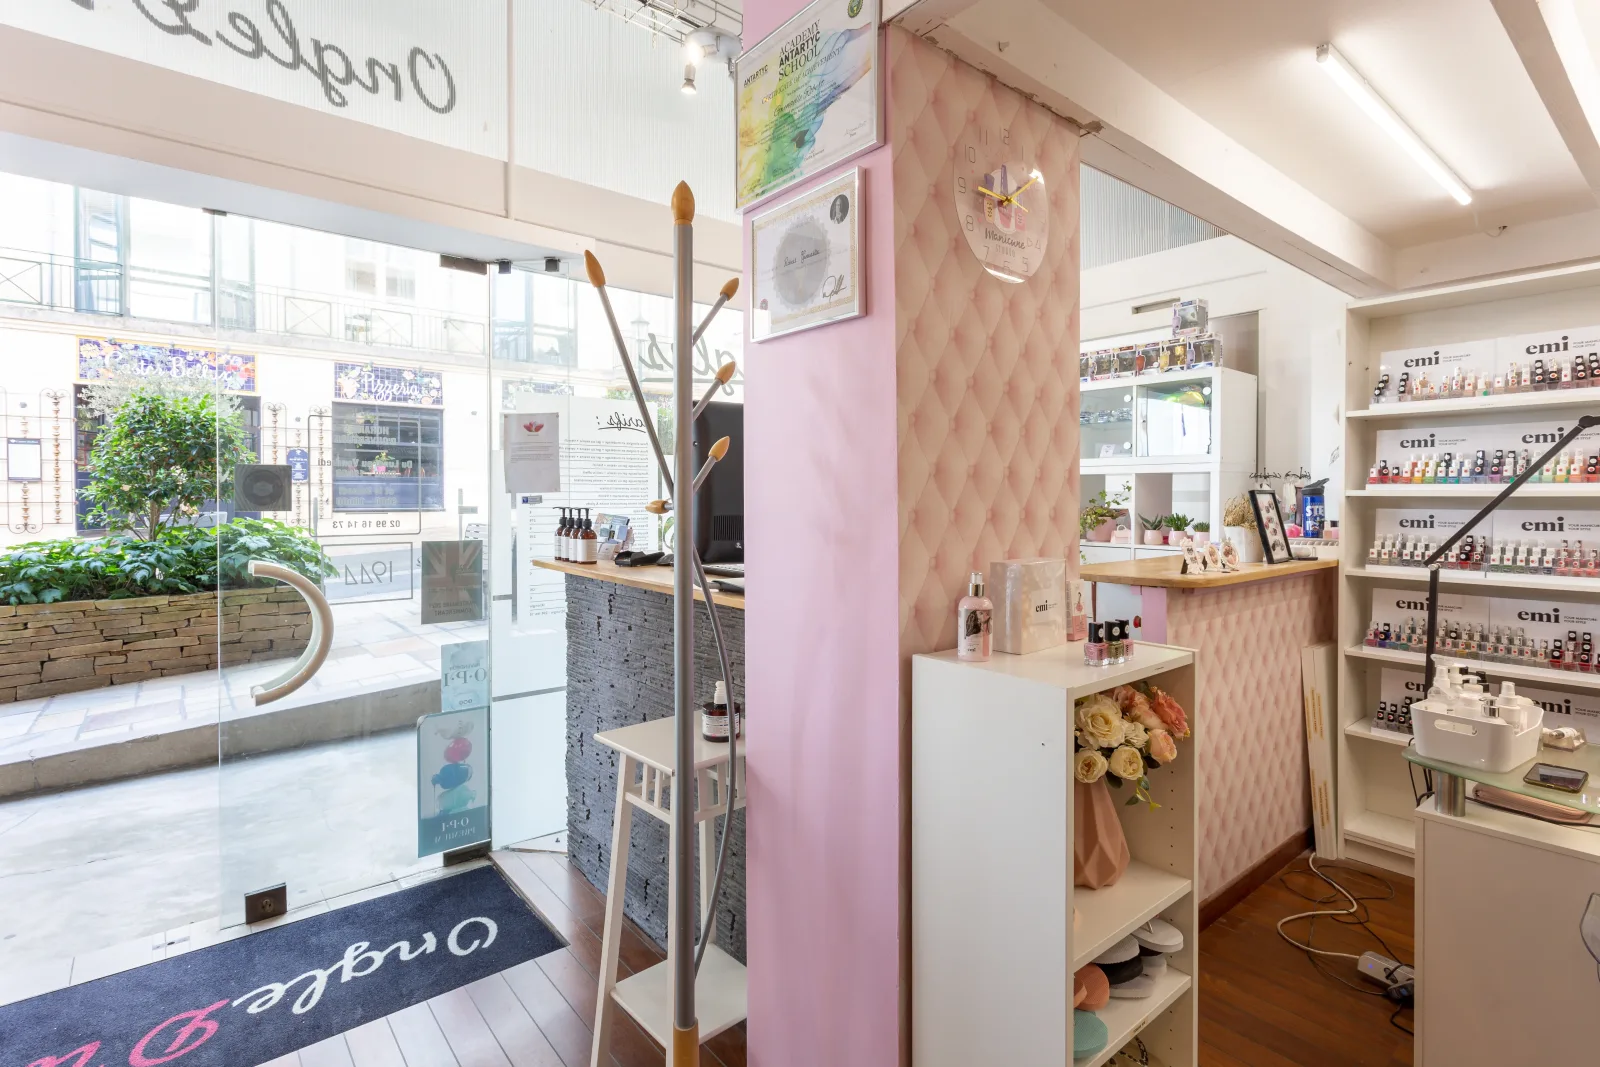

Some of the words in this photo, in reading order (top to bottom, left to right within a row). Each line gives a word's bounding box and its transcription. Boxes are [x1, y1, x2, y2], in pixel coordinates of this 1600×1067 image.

[779, 19, 821, 57] ACADEMY
[779, 30, 821, 68] ANTARTYC
[778, 44, 821, 82] SCHOOL
[743, 64, 768, 87] ANTARTYC
[965, 144, 976, 164] 10
[958, 176, 967, 194] 9
[965, 214, 974, 232] 8
[984, 227, 1026, 250] Manicure
[1526, 335, 1569, 355] emi
[1404, 350, 1440, 368] emi
[362, 371, 420, 402] Pizzeria
[1400, 433, 1436, 448] emi
[1521, 426, 1565, 444] emi
[1399, 514, 1435, 529] emi
[1521, 516, 1565, 532] emi
[1035, 600, 1048, 613] emi
[1517, 607, 1560, 624] emi
[232, 916, 499, 1014] Ongle
